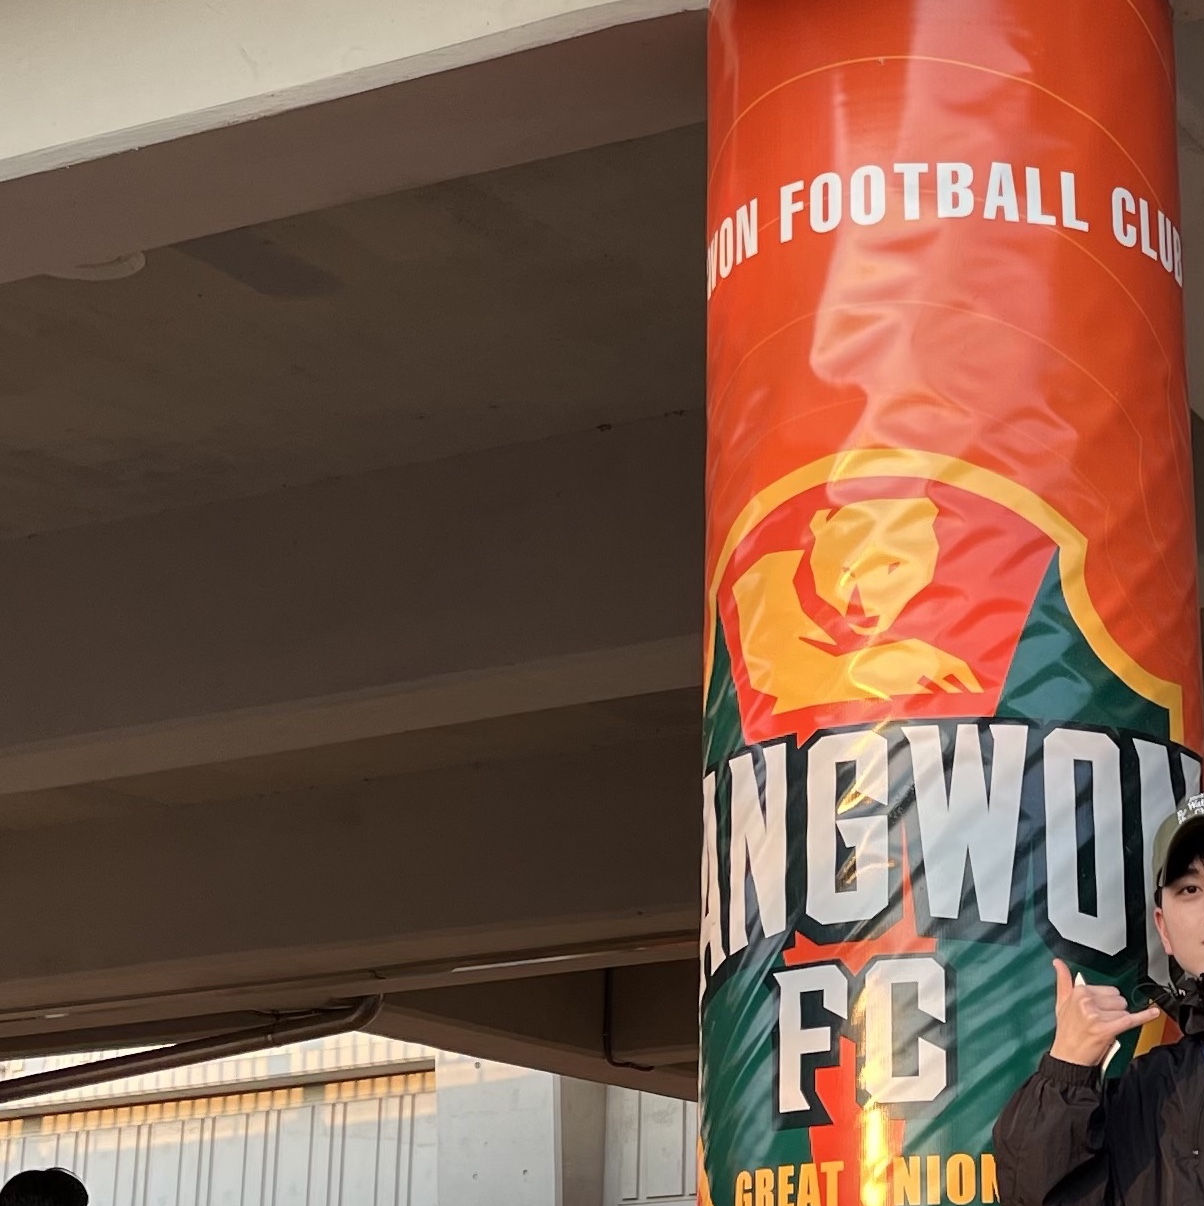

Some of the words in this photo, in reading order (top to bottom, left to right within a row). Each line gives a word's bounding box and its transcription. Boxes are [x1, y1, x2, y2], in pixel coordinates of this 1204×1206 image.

[780, 162, 1090, 243] FOOTBALL
[1112, 187, 1183, 288] CLUB
[774, 957, 946, 1113] FC
